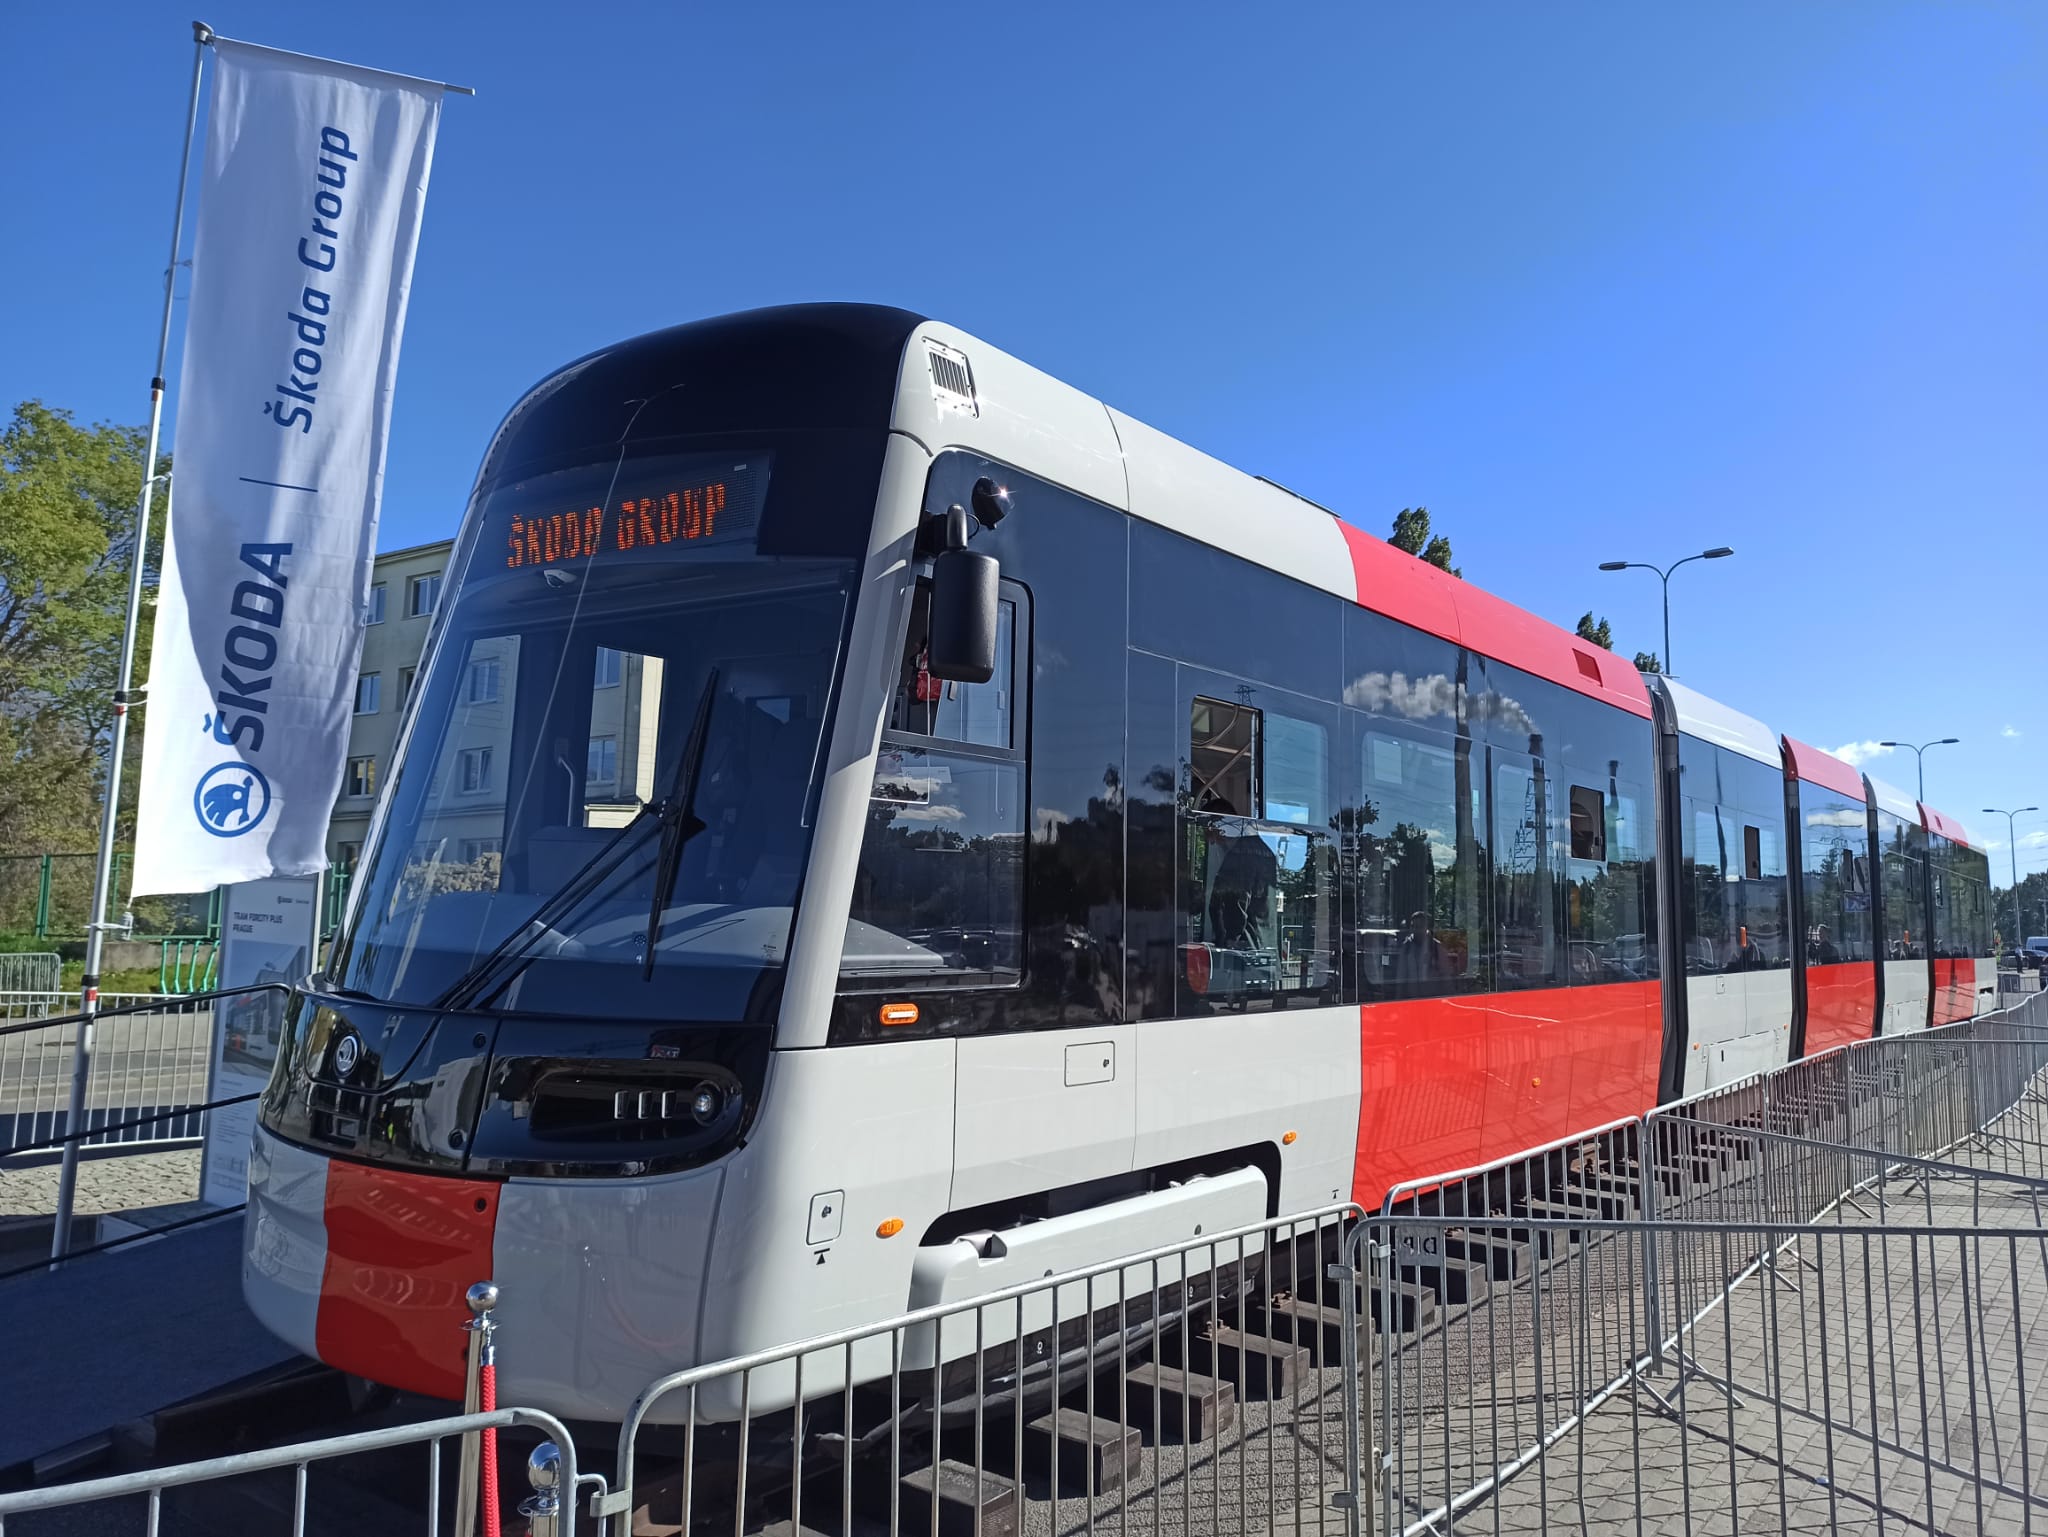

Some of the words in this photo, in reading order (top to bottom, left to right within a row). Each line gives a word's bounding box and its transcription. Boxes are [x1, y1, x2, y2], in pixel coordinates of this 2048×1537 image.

[263, 287, 331, 434] Škoda
[298, 126, 358, 272] Group
[617, 483, 725, 550] GROUP
[203, 542, 293, 753] ŠKODA
